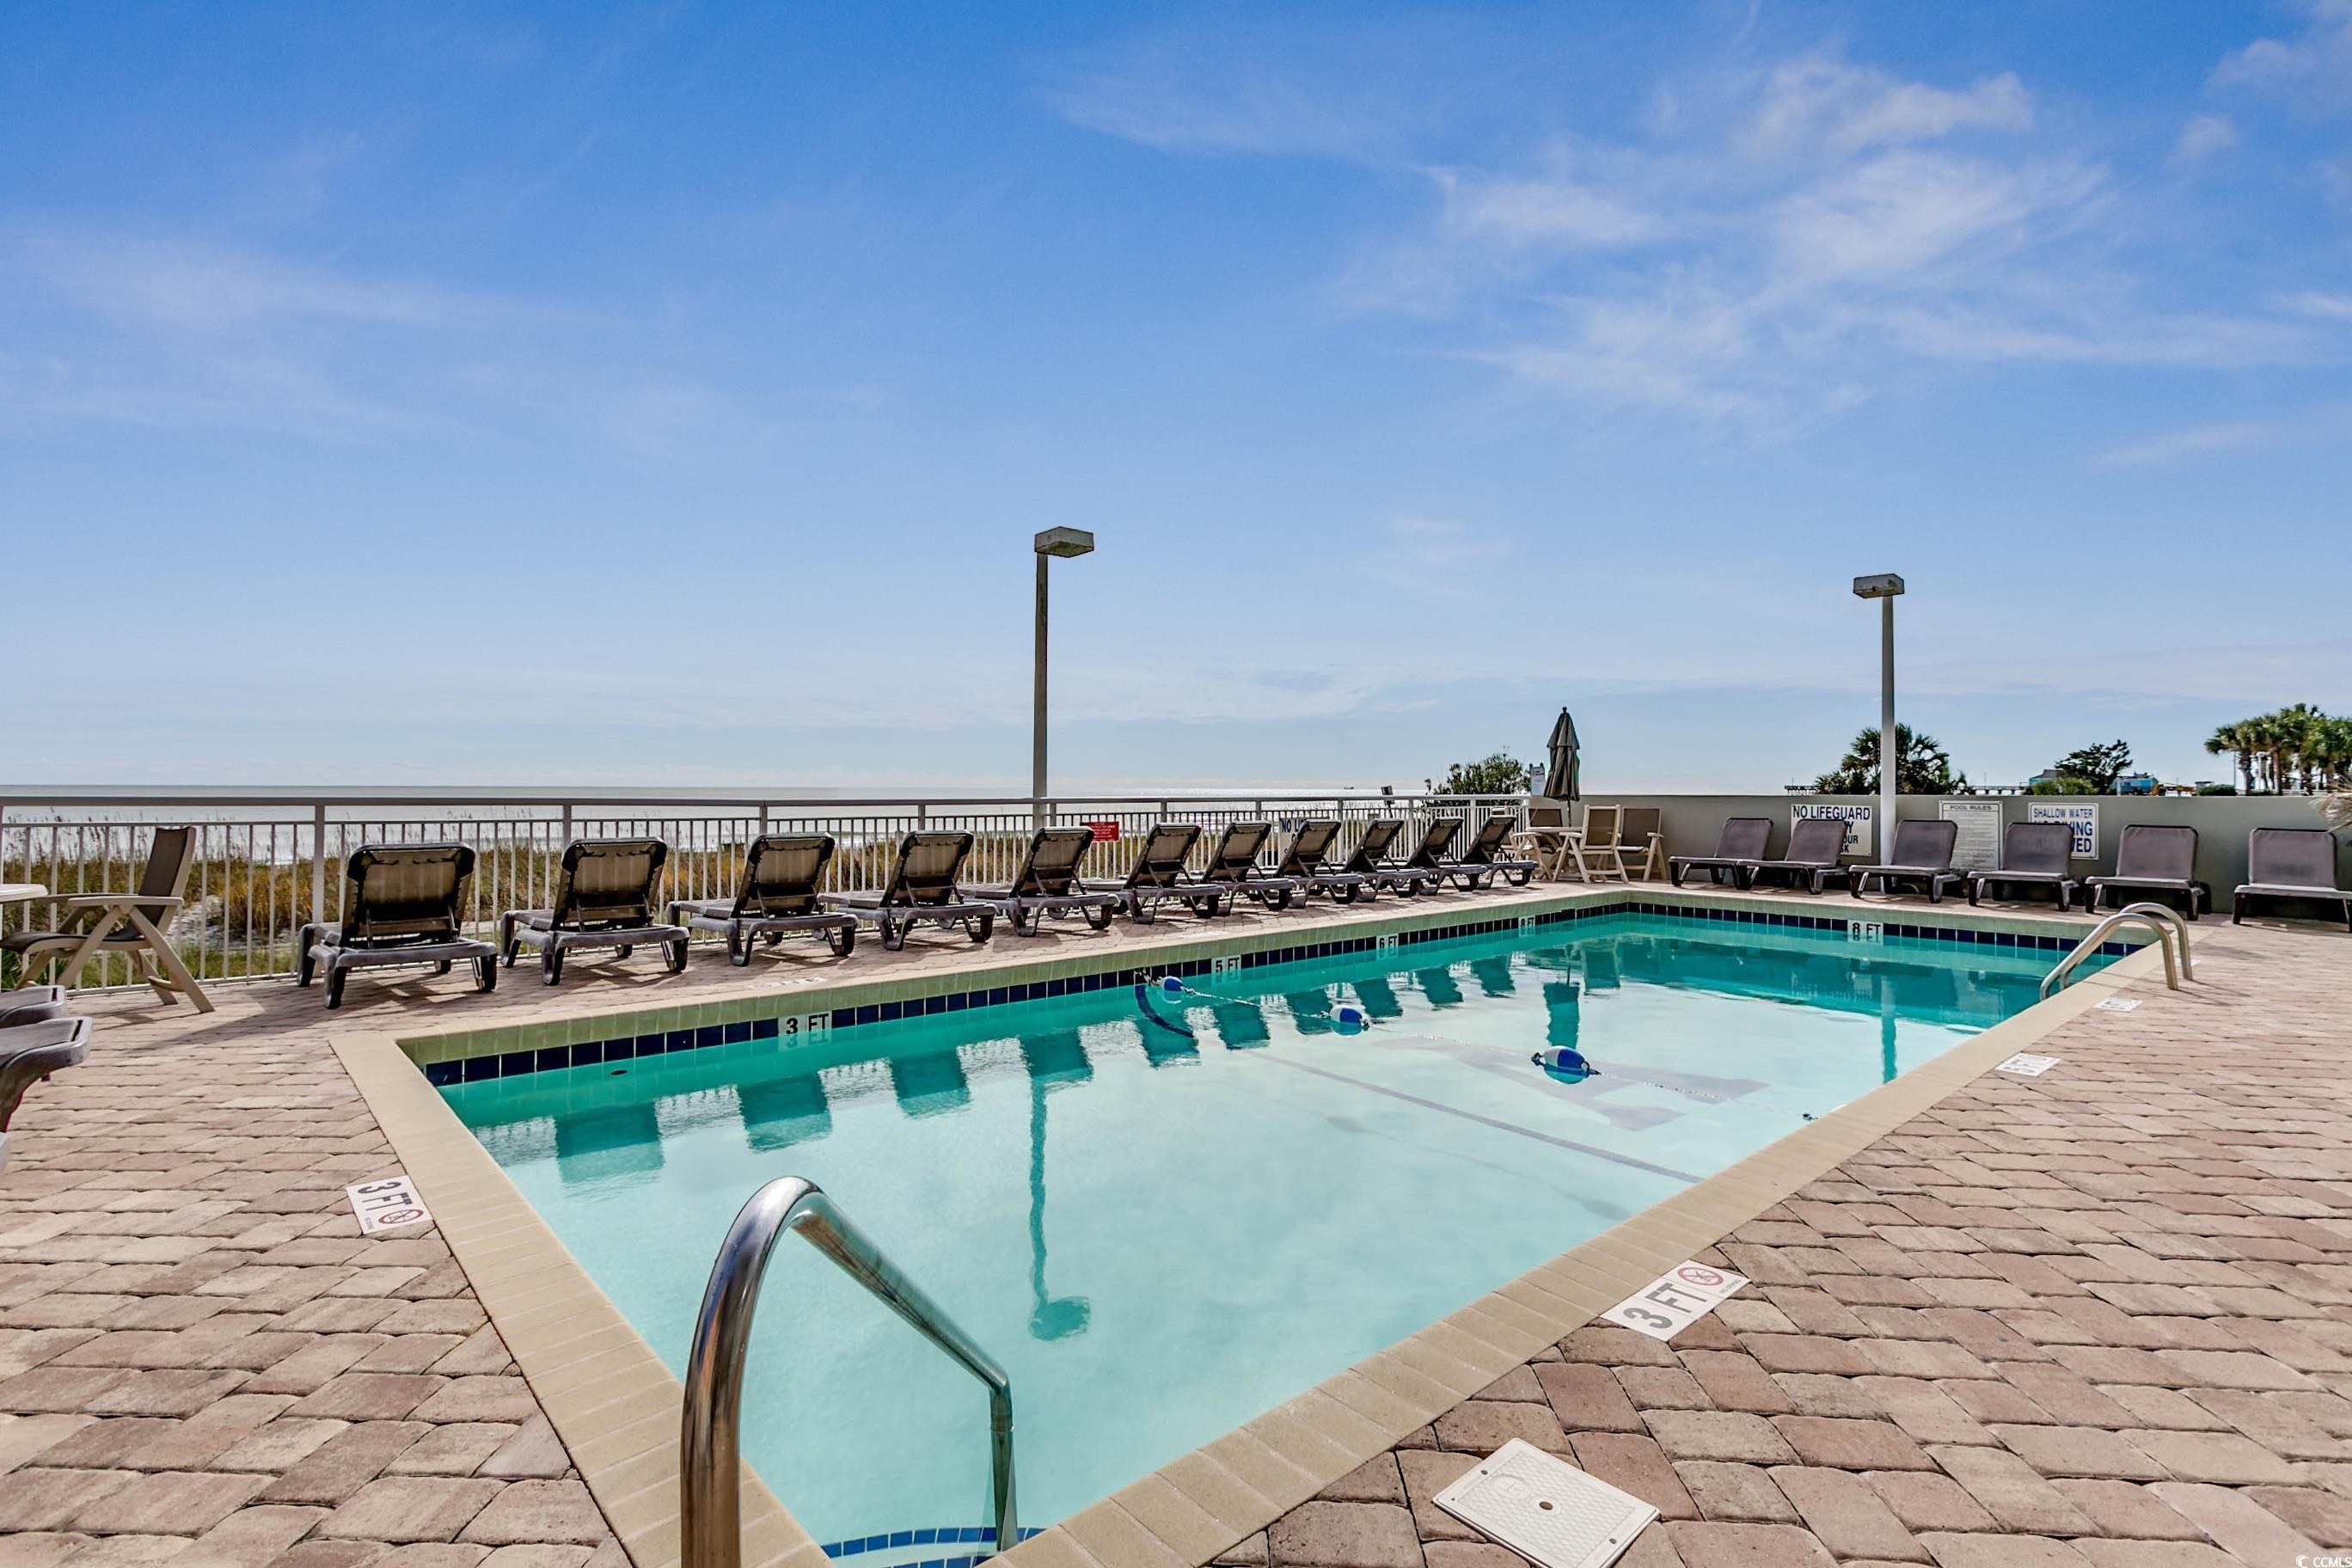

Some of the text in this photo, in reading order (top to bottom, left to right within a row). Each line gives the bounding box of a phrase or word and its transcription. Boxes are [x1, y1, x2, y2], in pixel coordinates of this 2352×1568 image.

[1793, 805, 1871, 820] NO LIFEGUARD
[2034, 808, 2093, 818] SHALLOW WATER
[1282, 818, 1292, 833] NO
[1853, 922, 1881, 936] 8 FT
[1379, 935, 1398, 948] 6 FT
[1215, 957, 1240, 972] 5 FT
[786, 1013, 829, 1035] 3 FT
[358, 1182, 413, 1210] 3 FT
[1645, 1282, 1707, 1314] FT
[1623, 1307, 1673, 1330] 3
